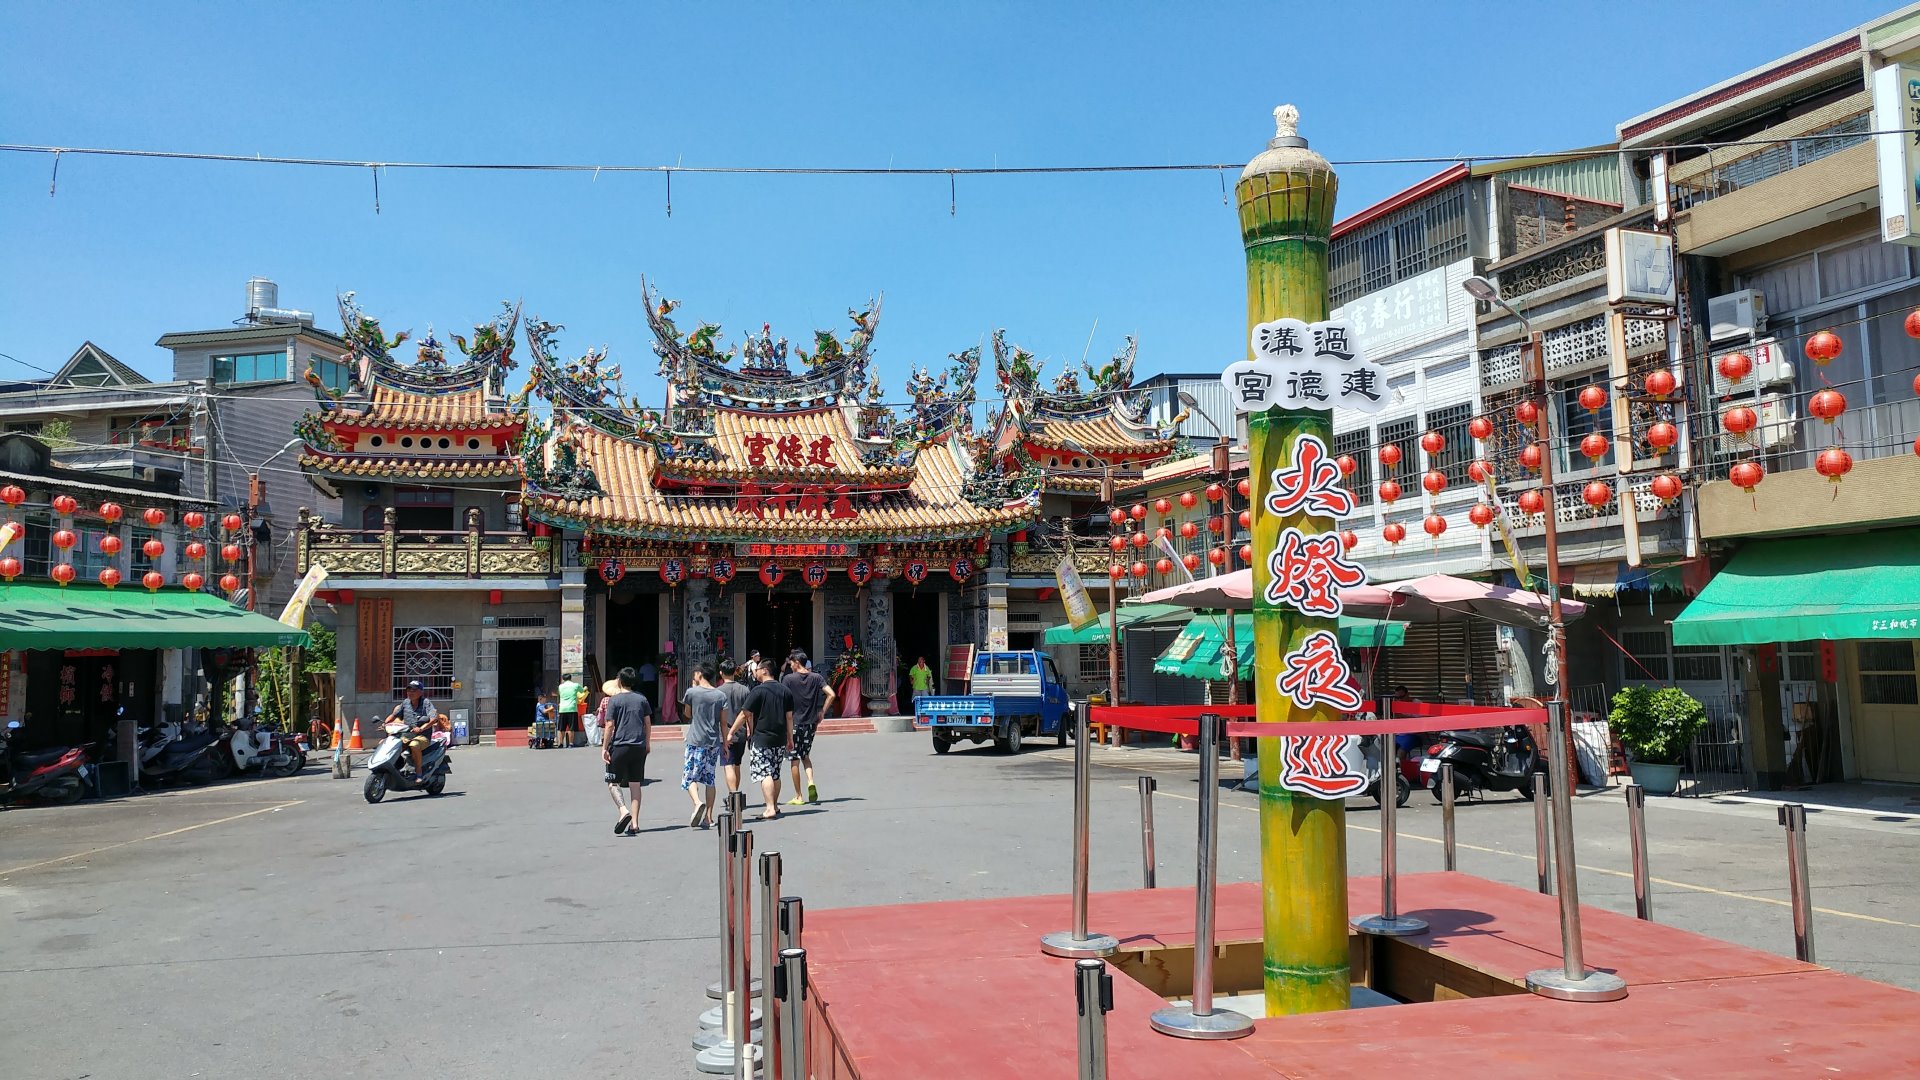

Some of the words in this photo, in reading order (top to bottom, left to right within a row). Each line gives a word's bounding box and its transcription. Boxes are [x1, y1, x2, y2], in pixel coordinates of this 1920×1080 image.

[1350, 287, 1414, 336] 富春行
[1260, 327, 1355, 360] 過溝
[1234, 367, 1381, 402] 建德宮
[743, 432, 838, 468] 建德宮
[733, 483, 859, 521] 五府千歲
[59, 665, 76, 706] 檳榔
